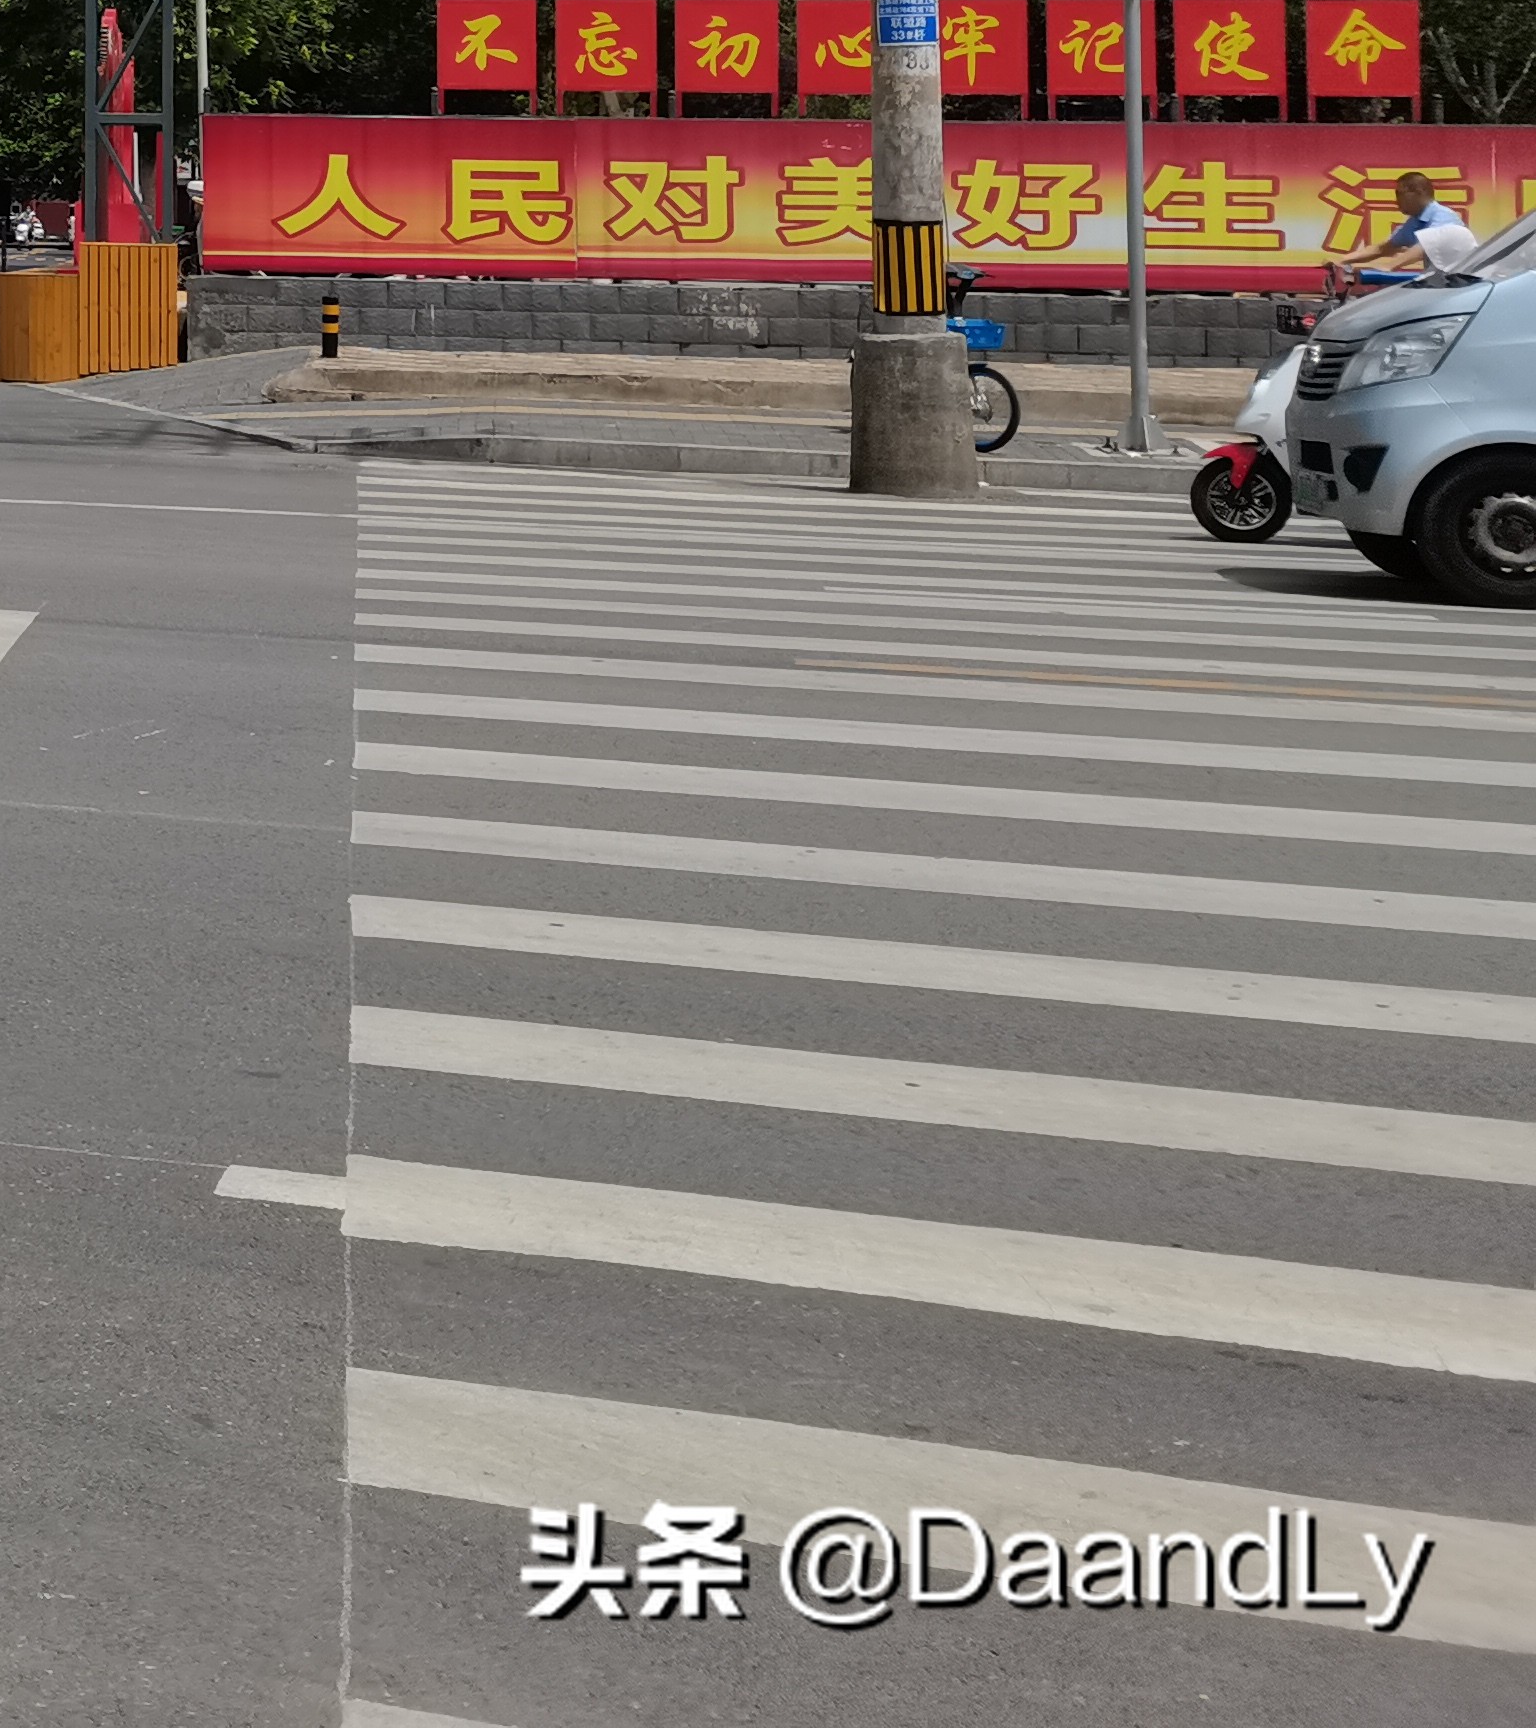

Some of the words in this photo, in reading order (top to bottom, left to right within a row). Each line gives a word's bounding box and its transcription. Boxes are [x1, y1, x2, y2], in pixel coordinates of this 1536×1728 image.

[277, 153, 1536, 253] 人民对美好生活
